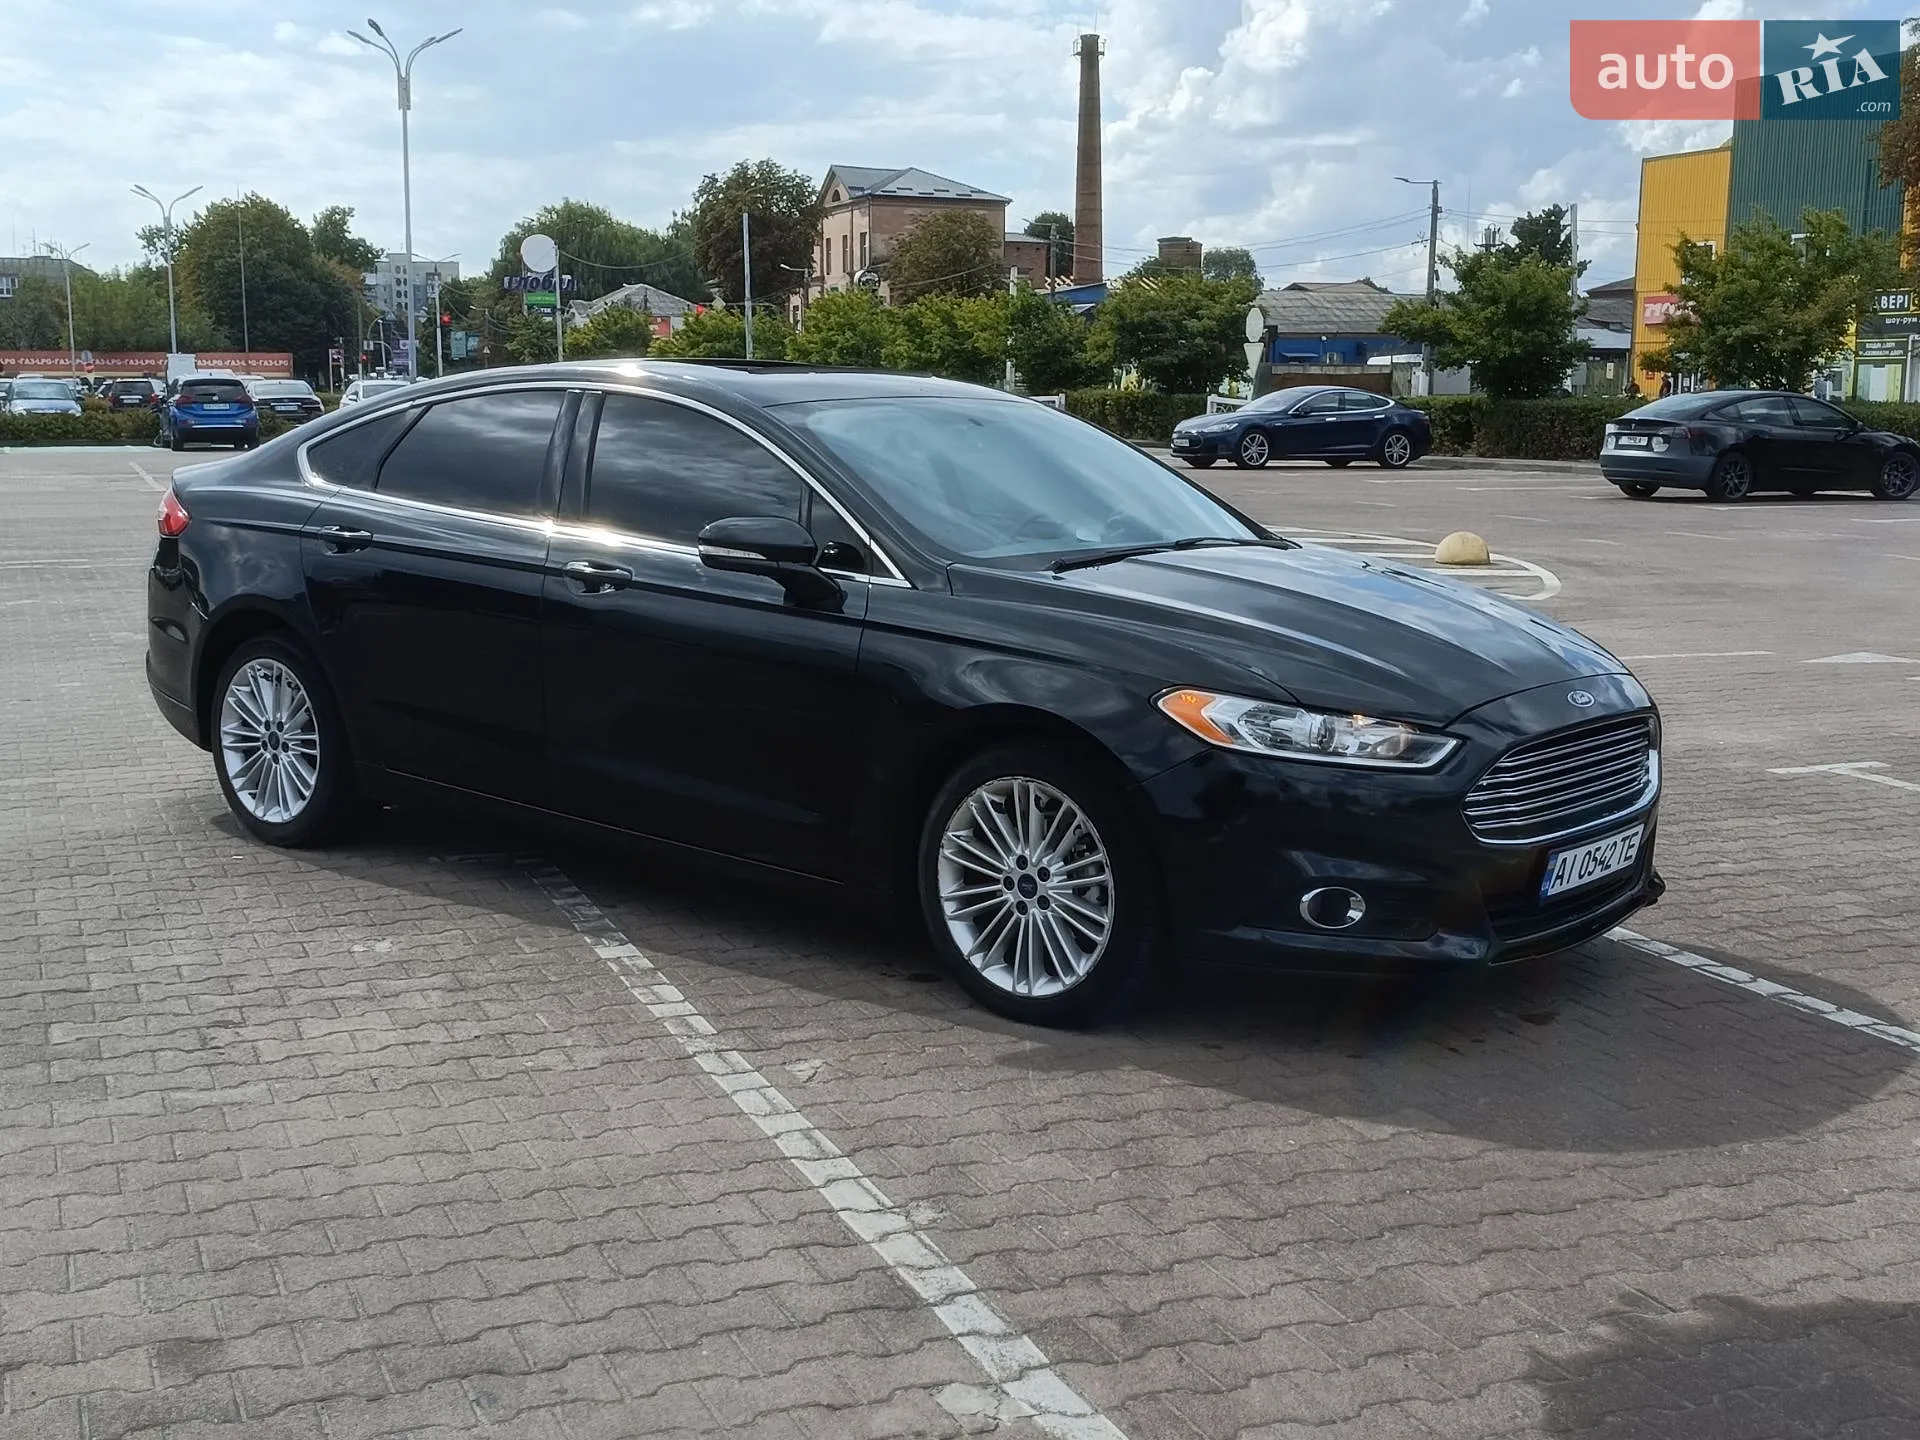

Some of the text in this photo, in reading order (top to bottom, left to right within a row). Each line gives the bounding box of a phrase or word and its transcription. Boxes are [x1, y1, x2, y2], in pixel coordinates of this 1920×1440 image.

[1551, 831, 1640, 889] AI 0542 TE
